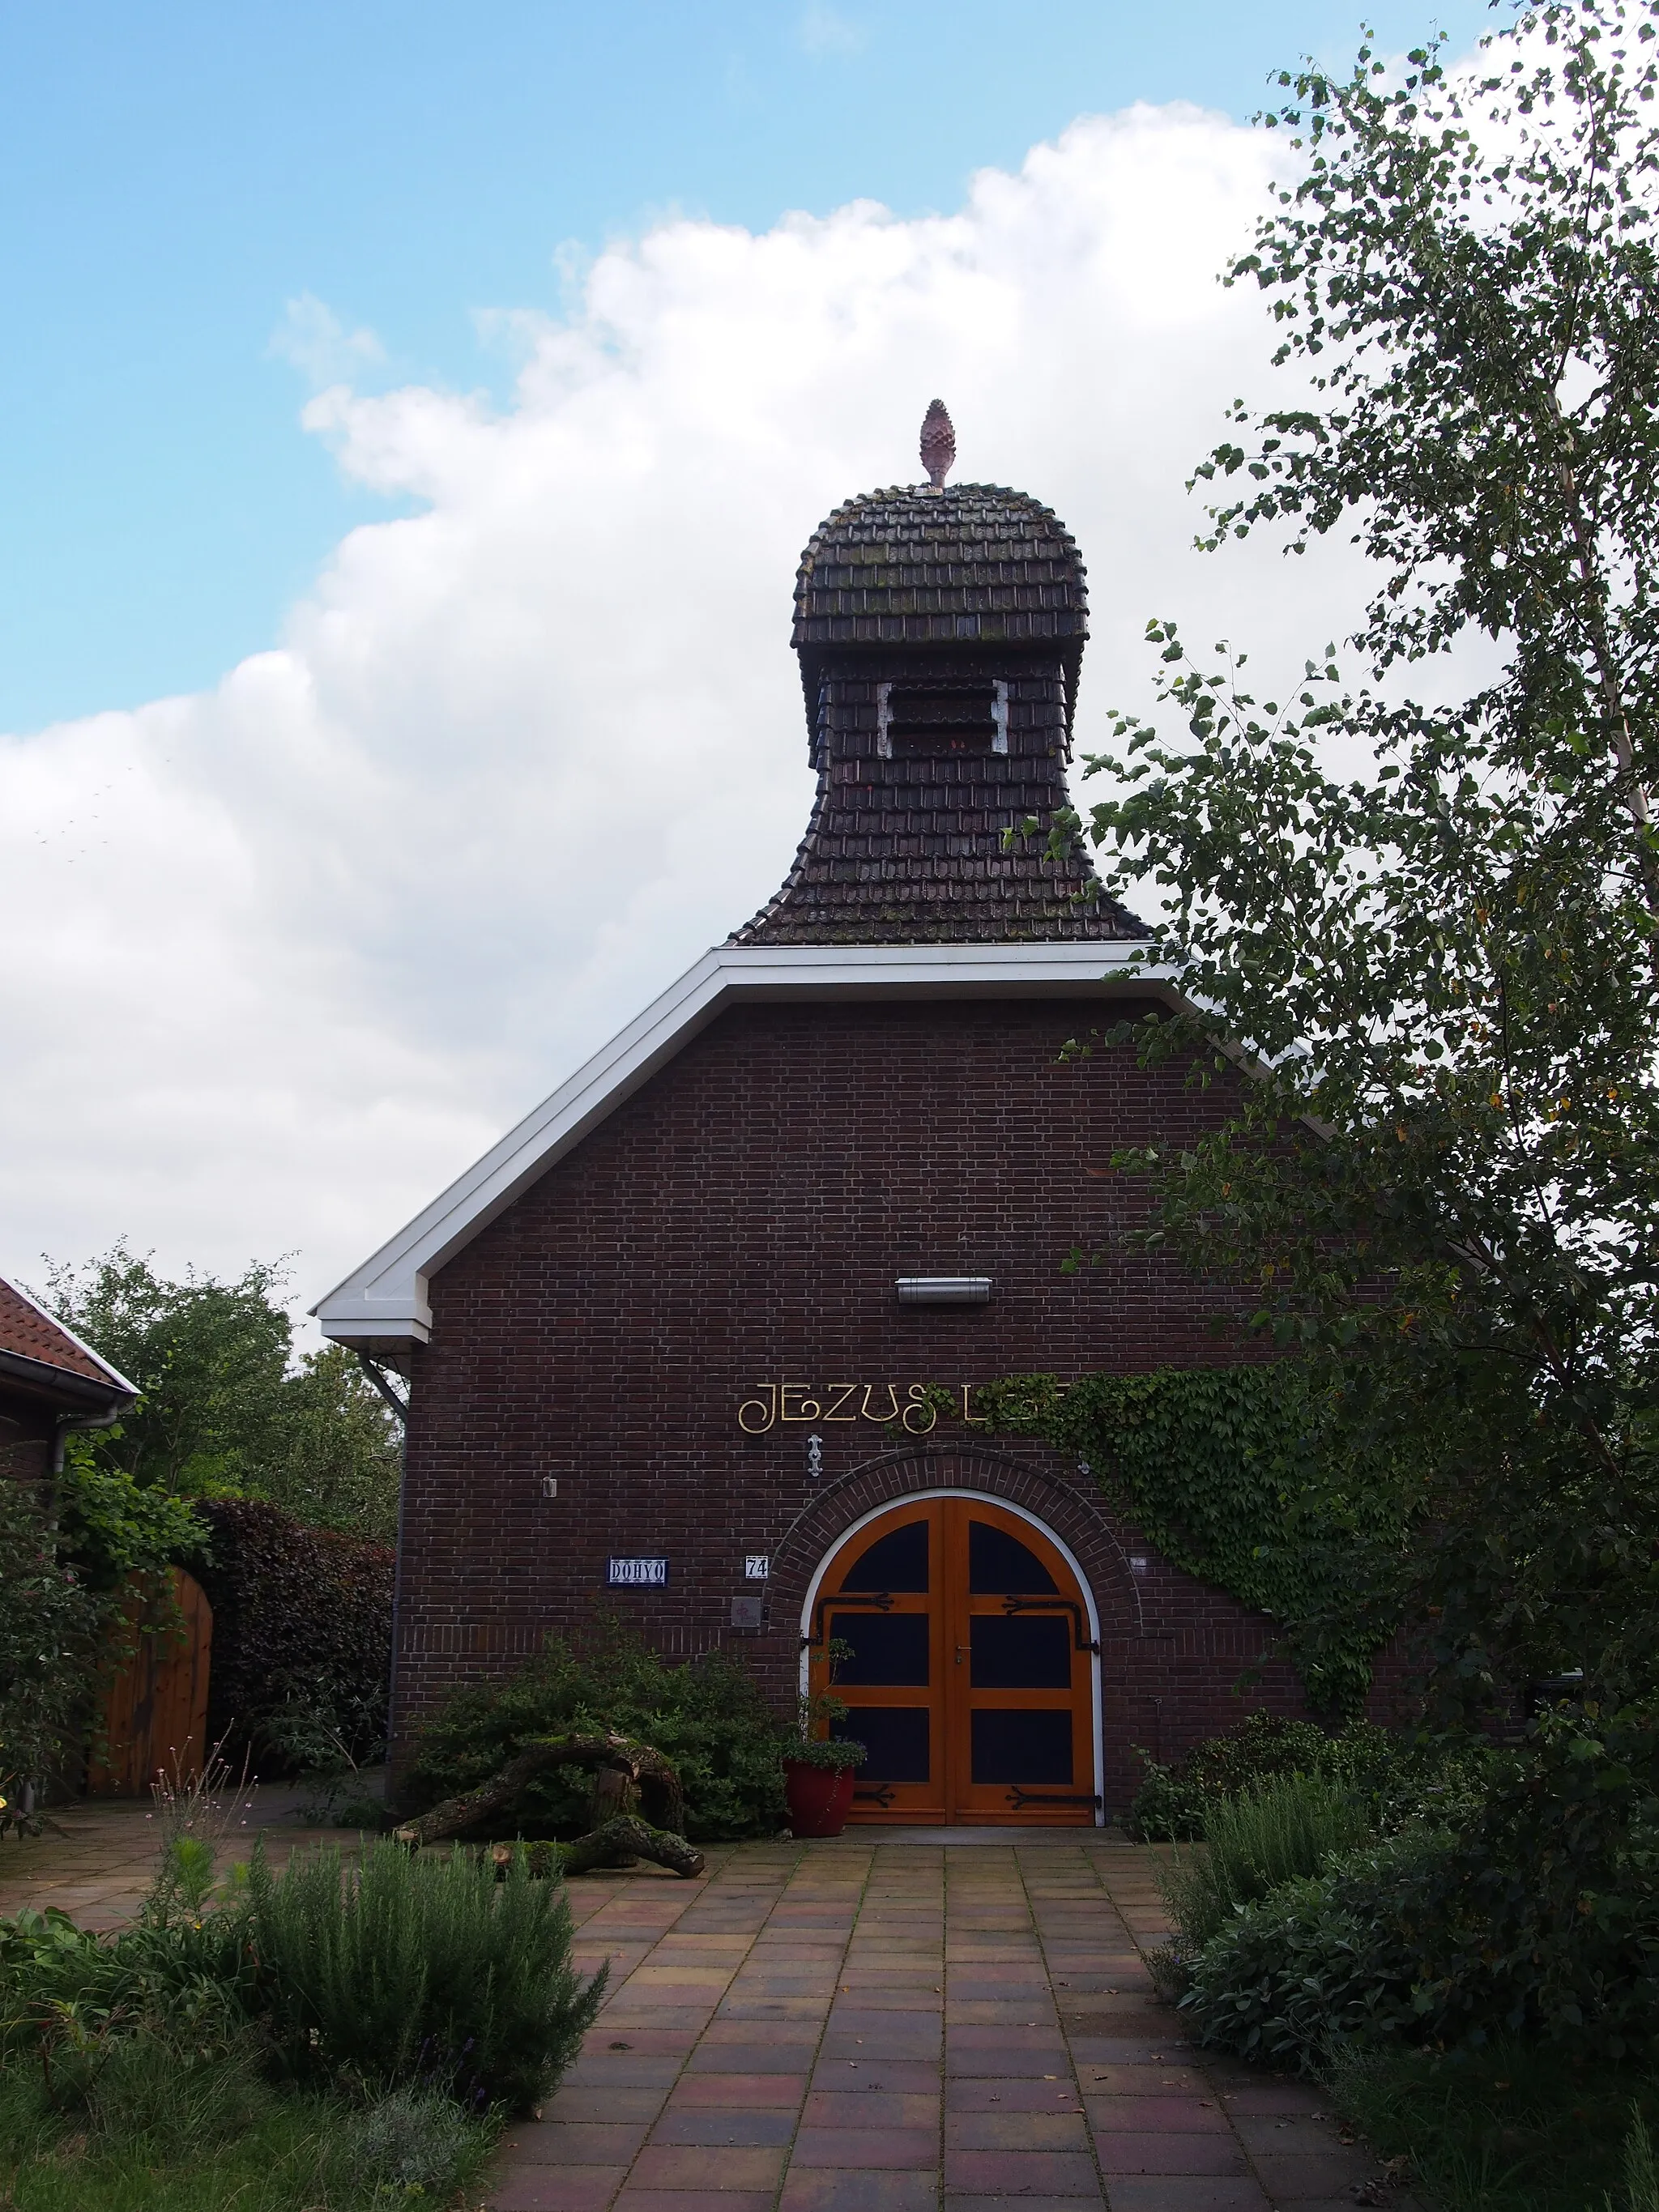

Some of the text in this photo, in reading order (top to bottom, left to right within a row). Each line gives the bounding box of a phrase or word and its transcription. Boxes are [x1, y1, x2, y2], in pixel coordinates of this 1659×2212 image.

[738, 1383, 936, 1434] JEZUS
[612, 1563, 663, 1579] DOHYO
[747, 1559, 767, 1575] 74
